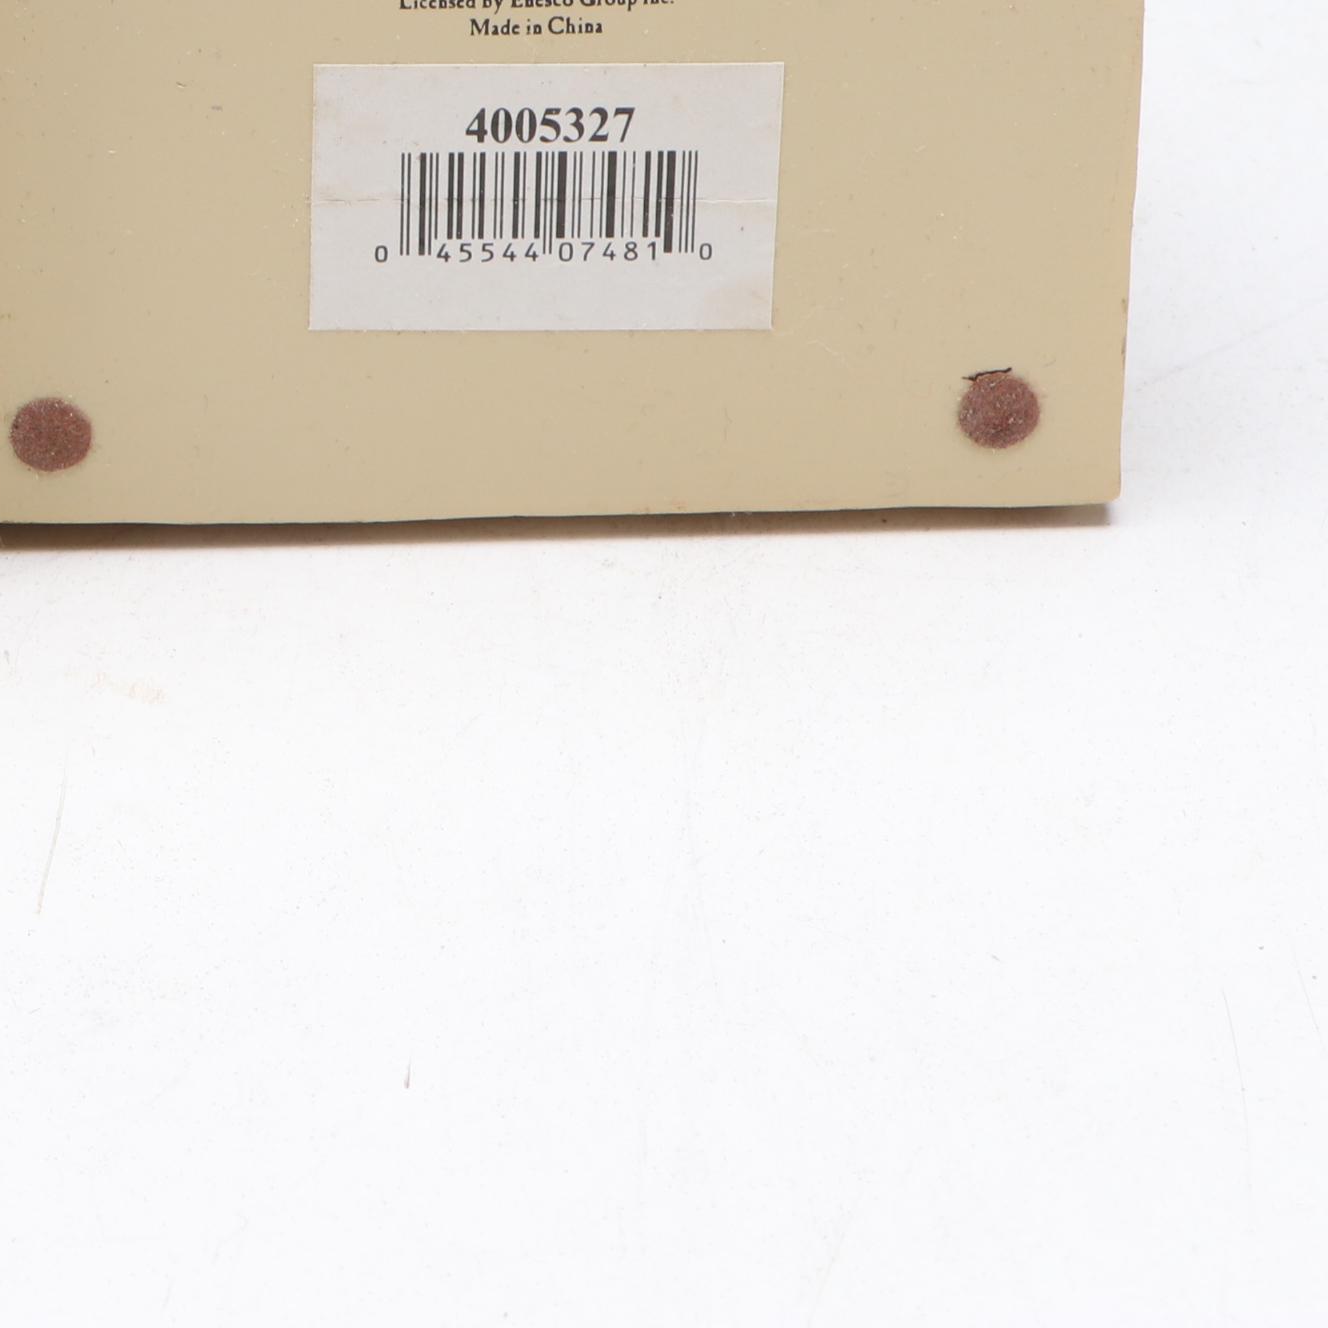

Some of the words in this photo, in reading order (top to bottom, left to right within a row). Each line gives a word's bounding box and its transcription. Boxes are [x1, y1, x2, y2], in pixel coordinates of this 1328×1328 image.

[470, 18, 520, 36] Made
[526, 18, 542, 35] in
[548, 16, 603, 35] China
[465, 106, 635, 143] 4005327
